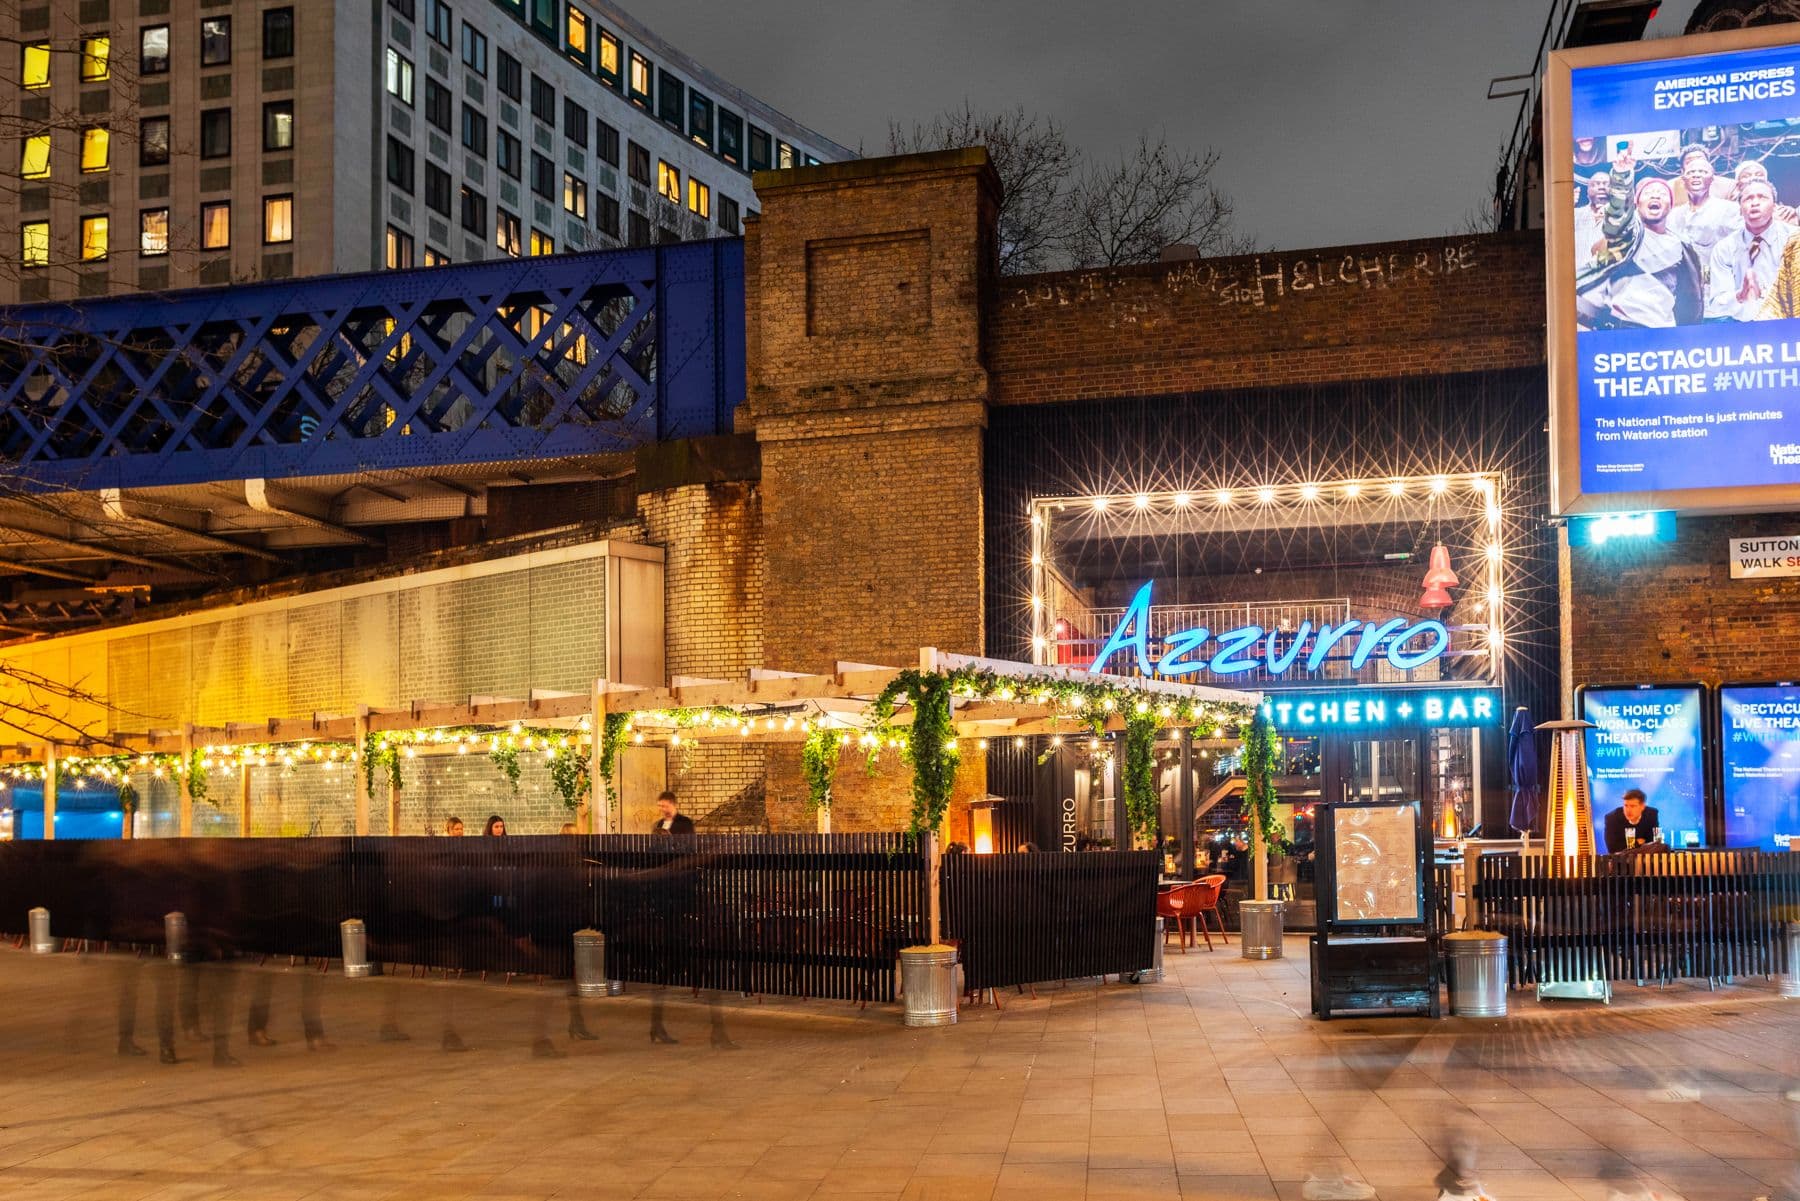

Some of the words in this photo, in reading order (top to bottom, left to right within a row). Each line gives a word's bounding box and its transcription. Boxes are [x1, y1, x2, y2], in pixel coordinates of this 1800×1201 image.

[1654, 74, 1727, 91] AMERICAN
[1730, 66, 1795, 83] EXPRESS
[1654, 79, 1796, 110] EXPERIENCES
[1593, 343, 1774, 373] SPECTACULAR
[1593, 372, 1707, 398] THEATRE
[1713, 367, 1800, 391] #WITH
[1595, 417, 1616, 428] The
[1617, 415, 1661, 427] National
[1662, 413, 1703, 426] Theatre
[1705, 412, 1715, 423] is
[1716, 411, 1737, 425] just
[1738, 409, 1784, 421] minutes
[1595, 429, 1621, 442] from
[1622, 428, 1669, 441] Waterloo
[1670, 427, 1708, 439] station
[1740, 540, 1799, 553] SUTTON
[1740, 557, 1782, 569] WALK
[1088, 578, 1450, 677] Azzurro
[1262, 700, 1386, 725] ITCHEN
[1425, 695, 1492, 720] BAR
[1597, 705, 1620, 717] THE
[1622, 704, 1662, 716] HOME
[1664, 703, 1682, 715] OF
[1595, 717, 1689, 730] WORLD-CLASS
[1732, 717, 1762, 729] LIVE
[1595, 732, 1653, 744] THEATRE
[1062, 798, 1076, 853] ZURRO
